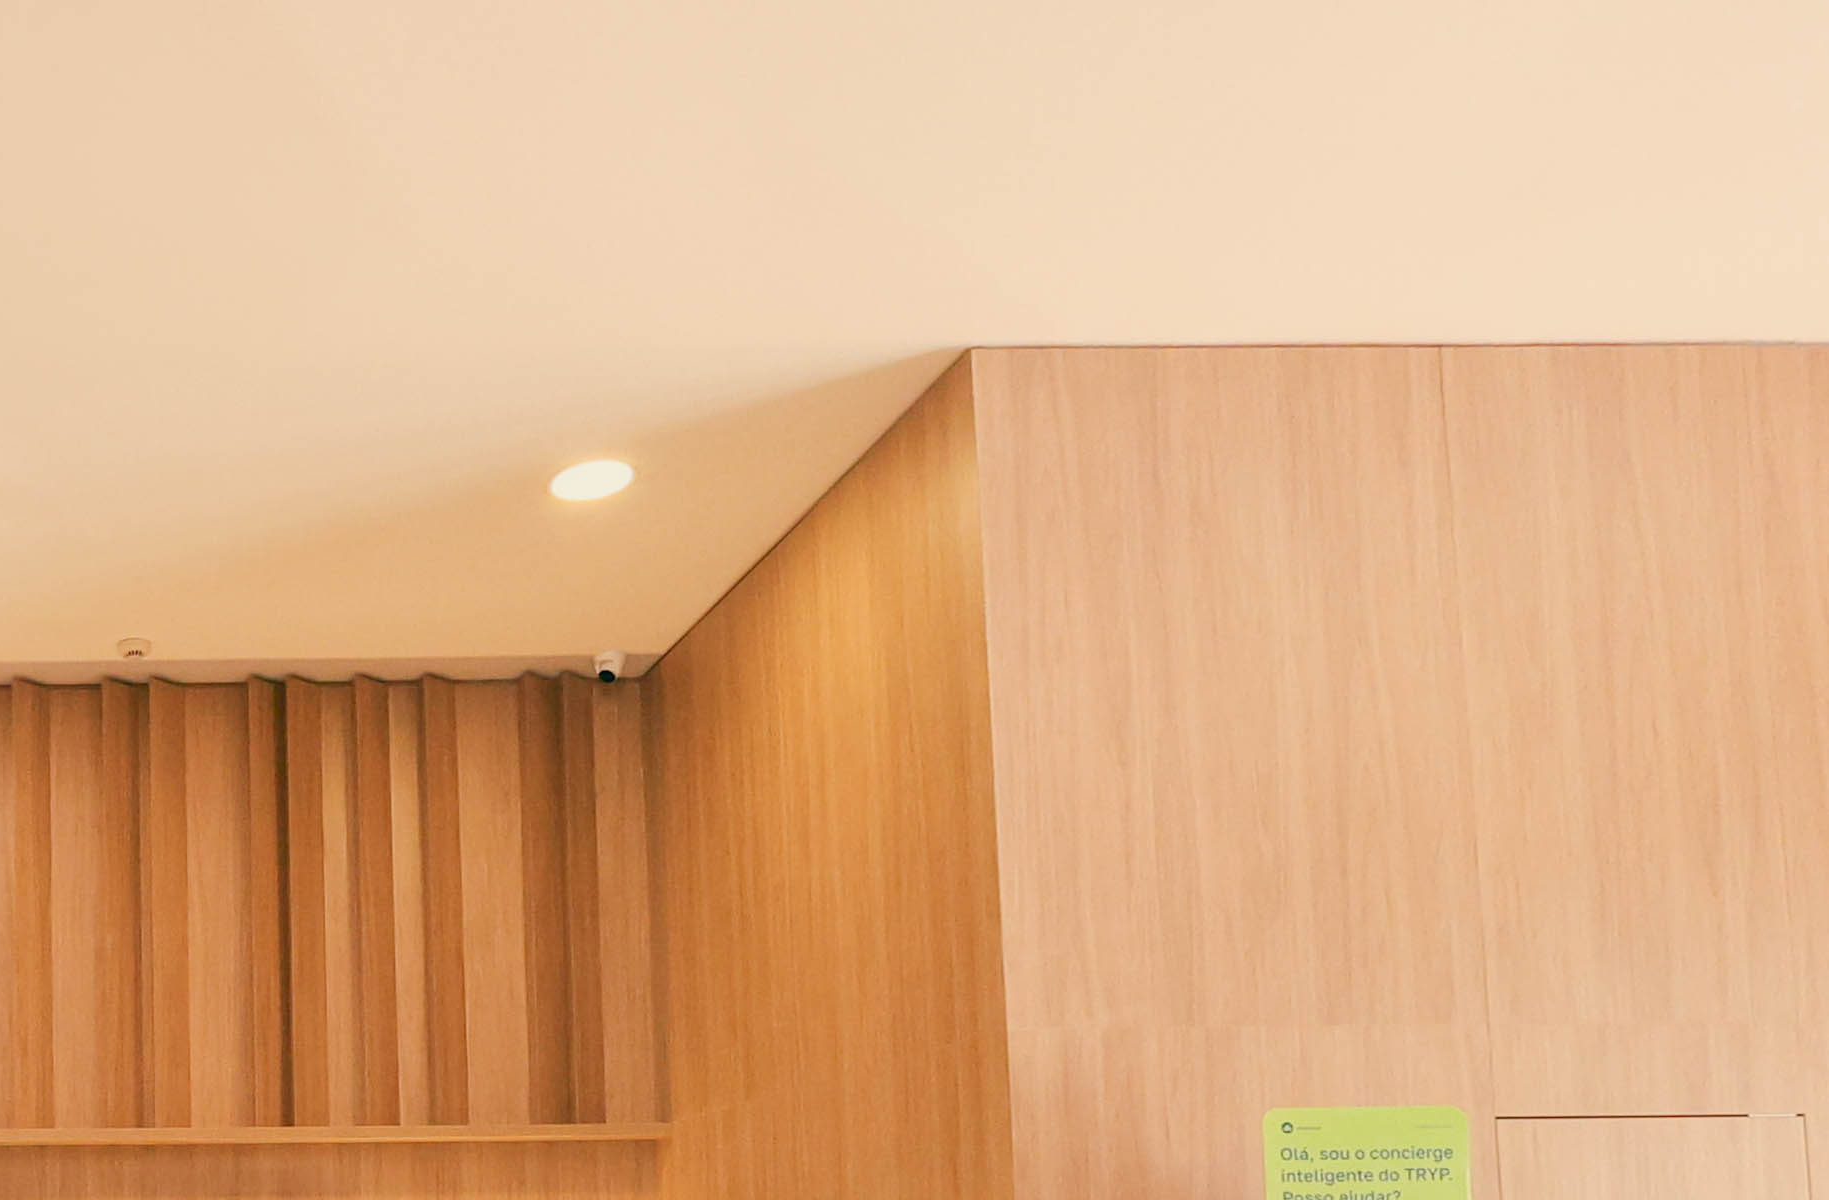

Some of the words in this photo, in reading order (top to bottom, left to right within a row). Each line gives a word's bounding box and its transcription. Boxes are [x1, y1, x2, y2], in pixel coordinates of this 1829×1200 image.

[1280, 1147, 1314, 1162] Olá,
[1320, 1150, 1349, 1161] sou
[1355, 1150, 1366, 1161] o
[1369, 1146, 1454, 1162] concierge
[1281, 1169, 1374, 1186] inteligente
[1379, 1169, 1400, 1182] do
[1404, 1168, 1454, 1182] TRYP.
